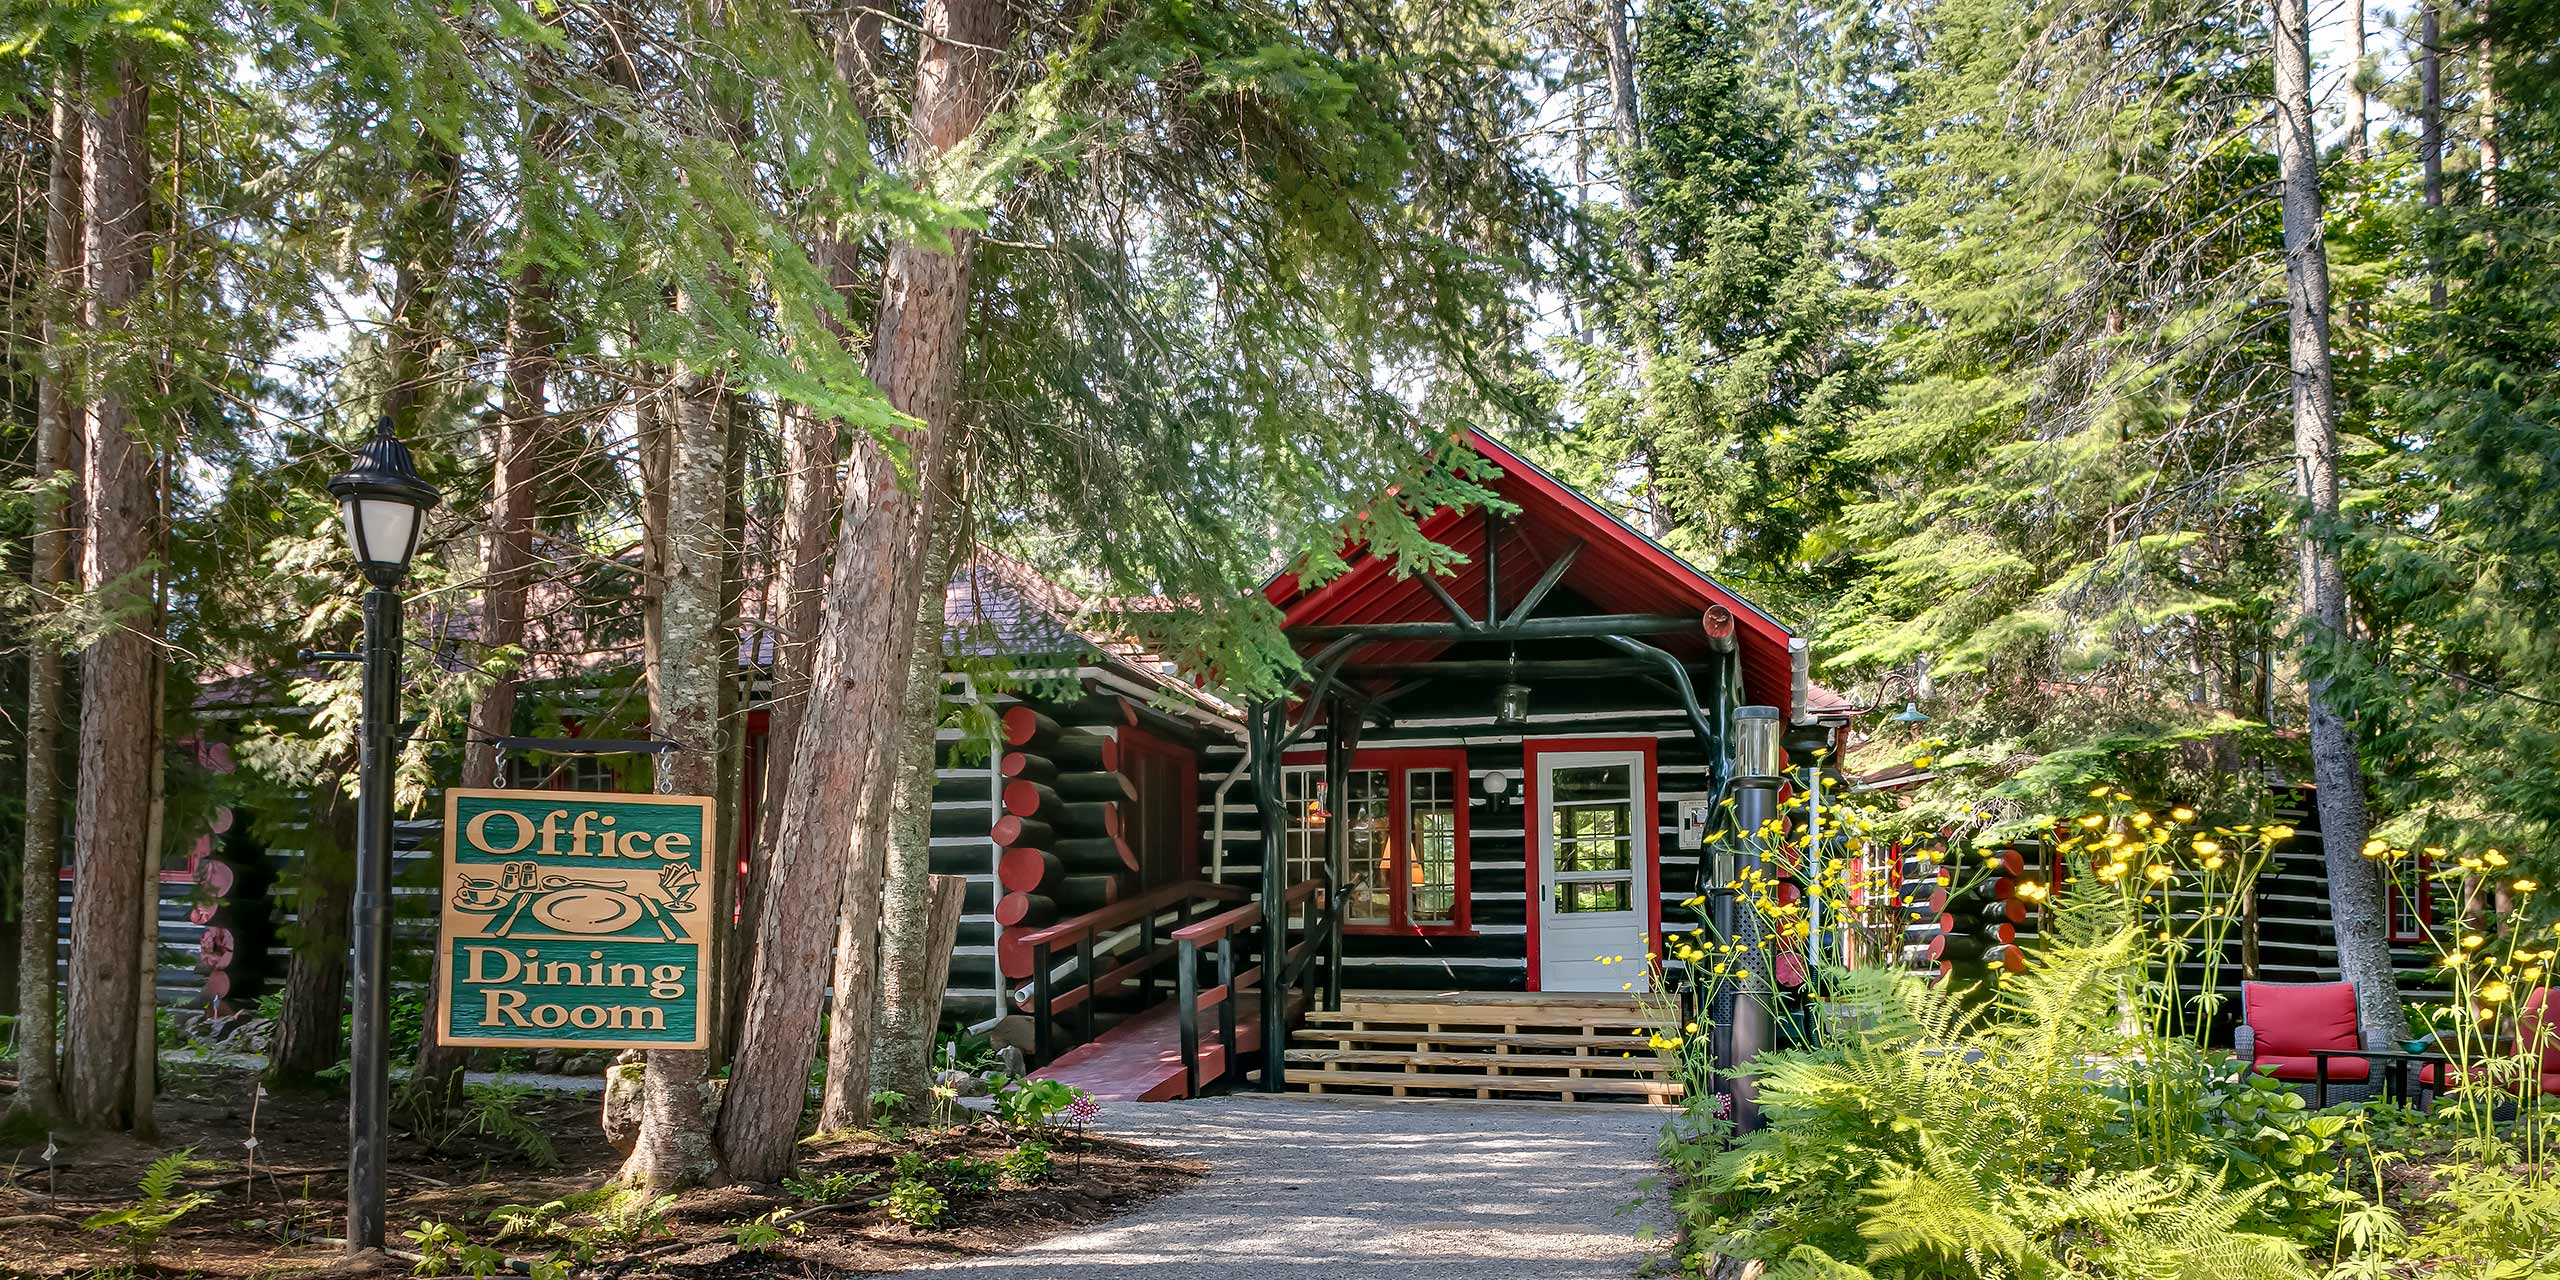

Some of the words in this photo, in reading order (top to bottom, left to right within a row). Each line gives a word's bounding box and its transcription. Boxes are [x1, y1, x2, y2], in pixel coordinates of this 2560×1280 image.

[466, 810, 692, 859] Office
[462, 946, 686, 999] Dining
[478, 989, 667, 1030] Room
